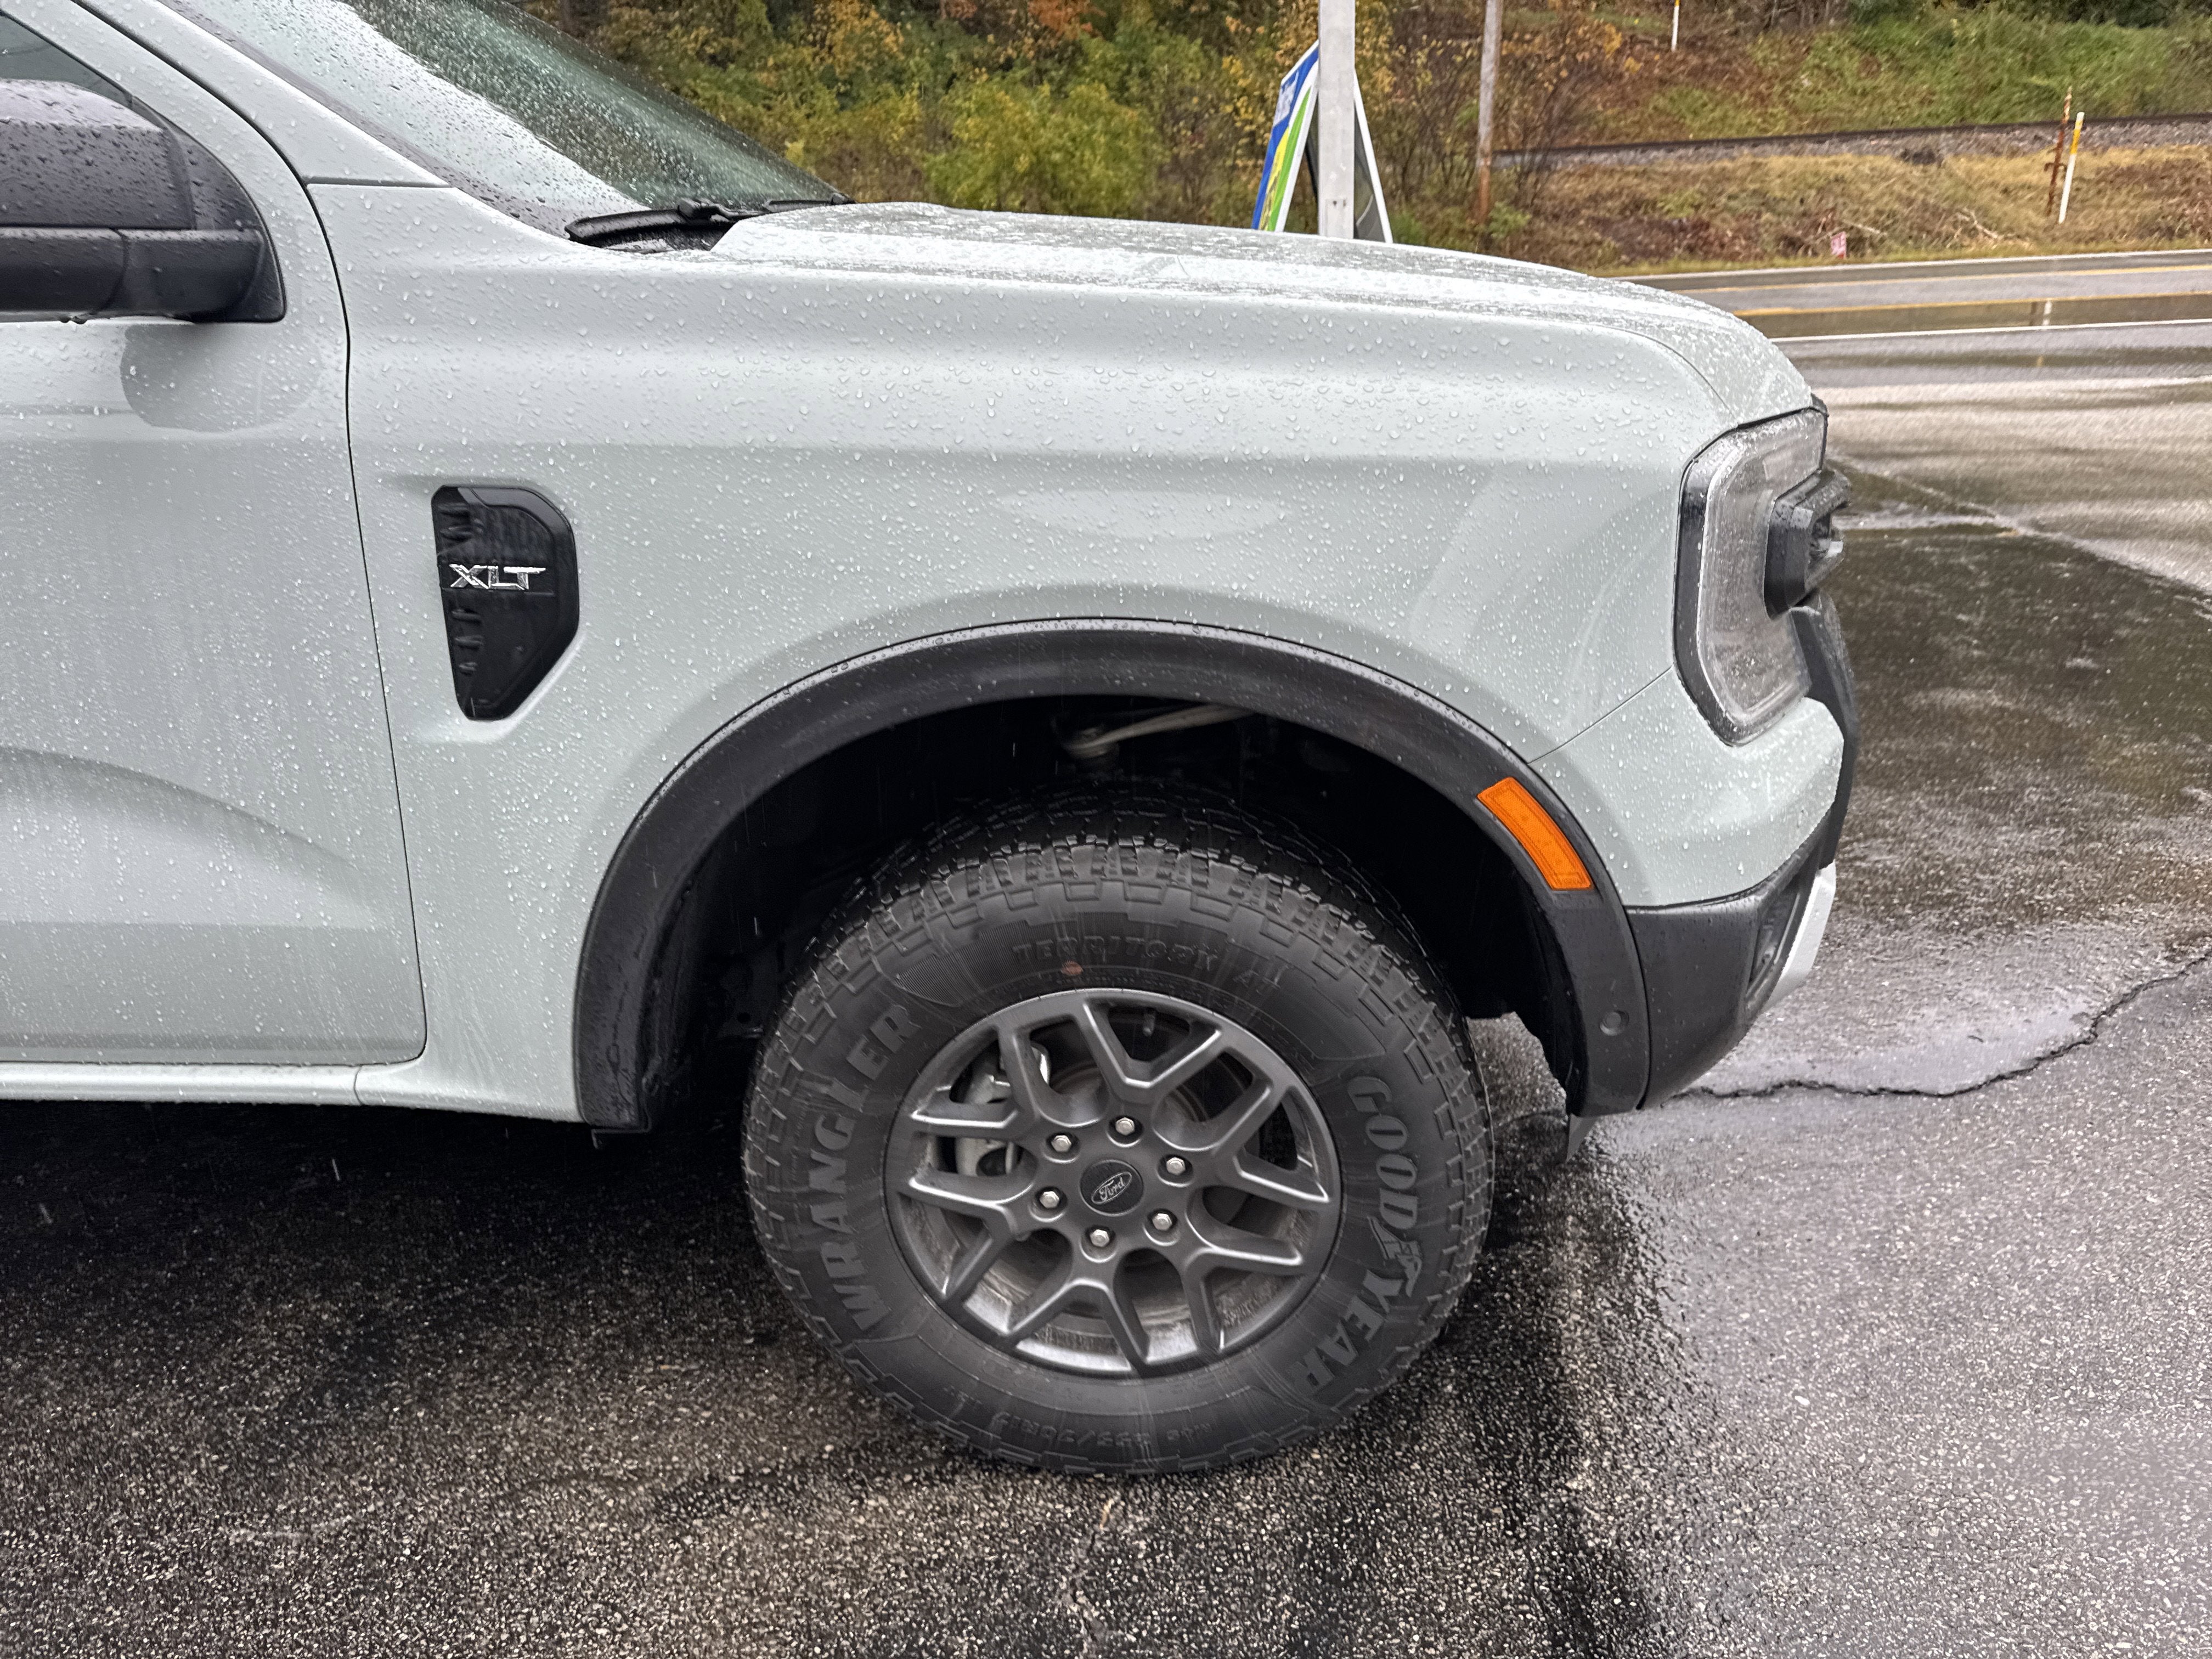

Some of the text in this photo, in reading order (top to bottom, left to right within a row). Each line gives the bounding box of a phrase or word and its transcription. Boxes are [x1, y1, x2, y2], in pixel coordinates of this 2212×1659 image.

[449, 563, 546, 591] XLT
[808, 1003, 922, 1331] WRANGLER
[1097, 1176, 1127, 1201] Ford
[1287, 1076, 1422, 1391] GOODYEAR
